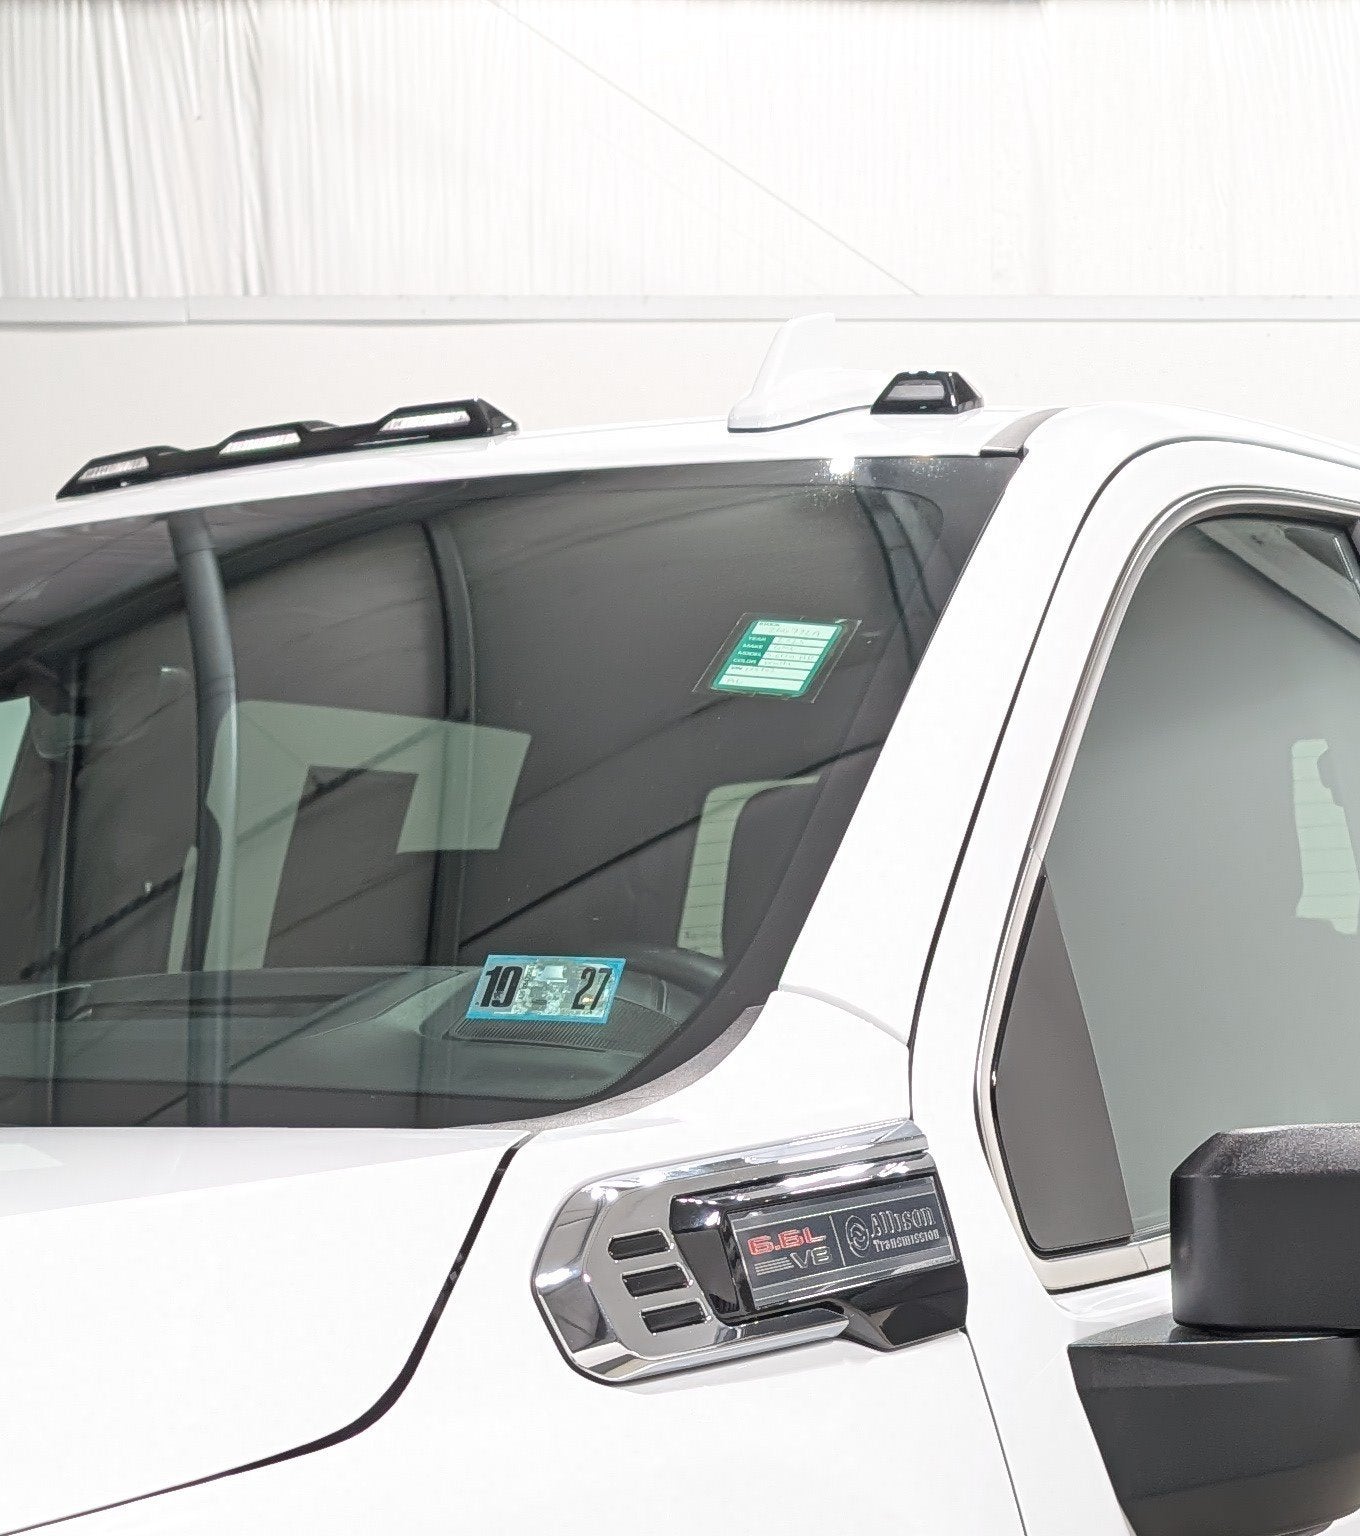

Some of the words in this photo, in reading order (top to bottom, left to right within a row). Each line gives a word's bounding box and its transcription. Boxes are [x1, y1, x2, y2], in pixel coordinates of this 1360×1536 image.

[480, 965, 523, 1008] 10
[571, 966, 613, 1011] 27
[870, 1206, 937, 1238] Allison
[747, 1226, 827, 1257] 6.6L
[872, 1228, 940, 1254] Transmission
